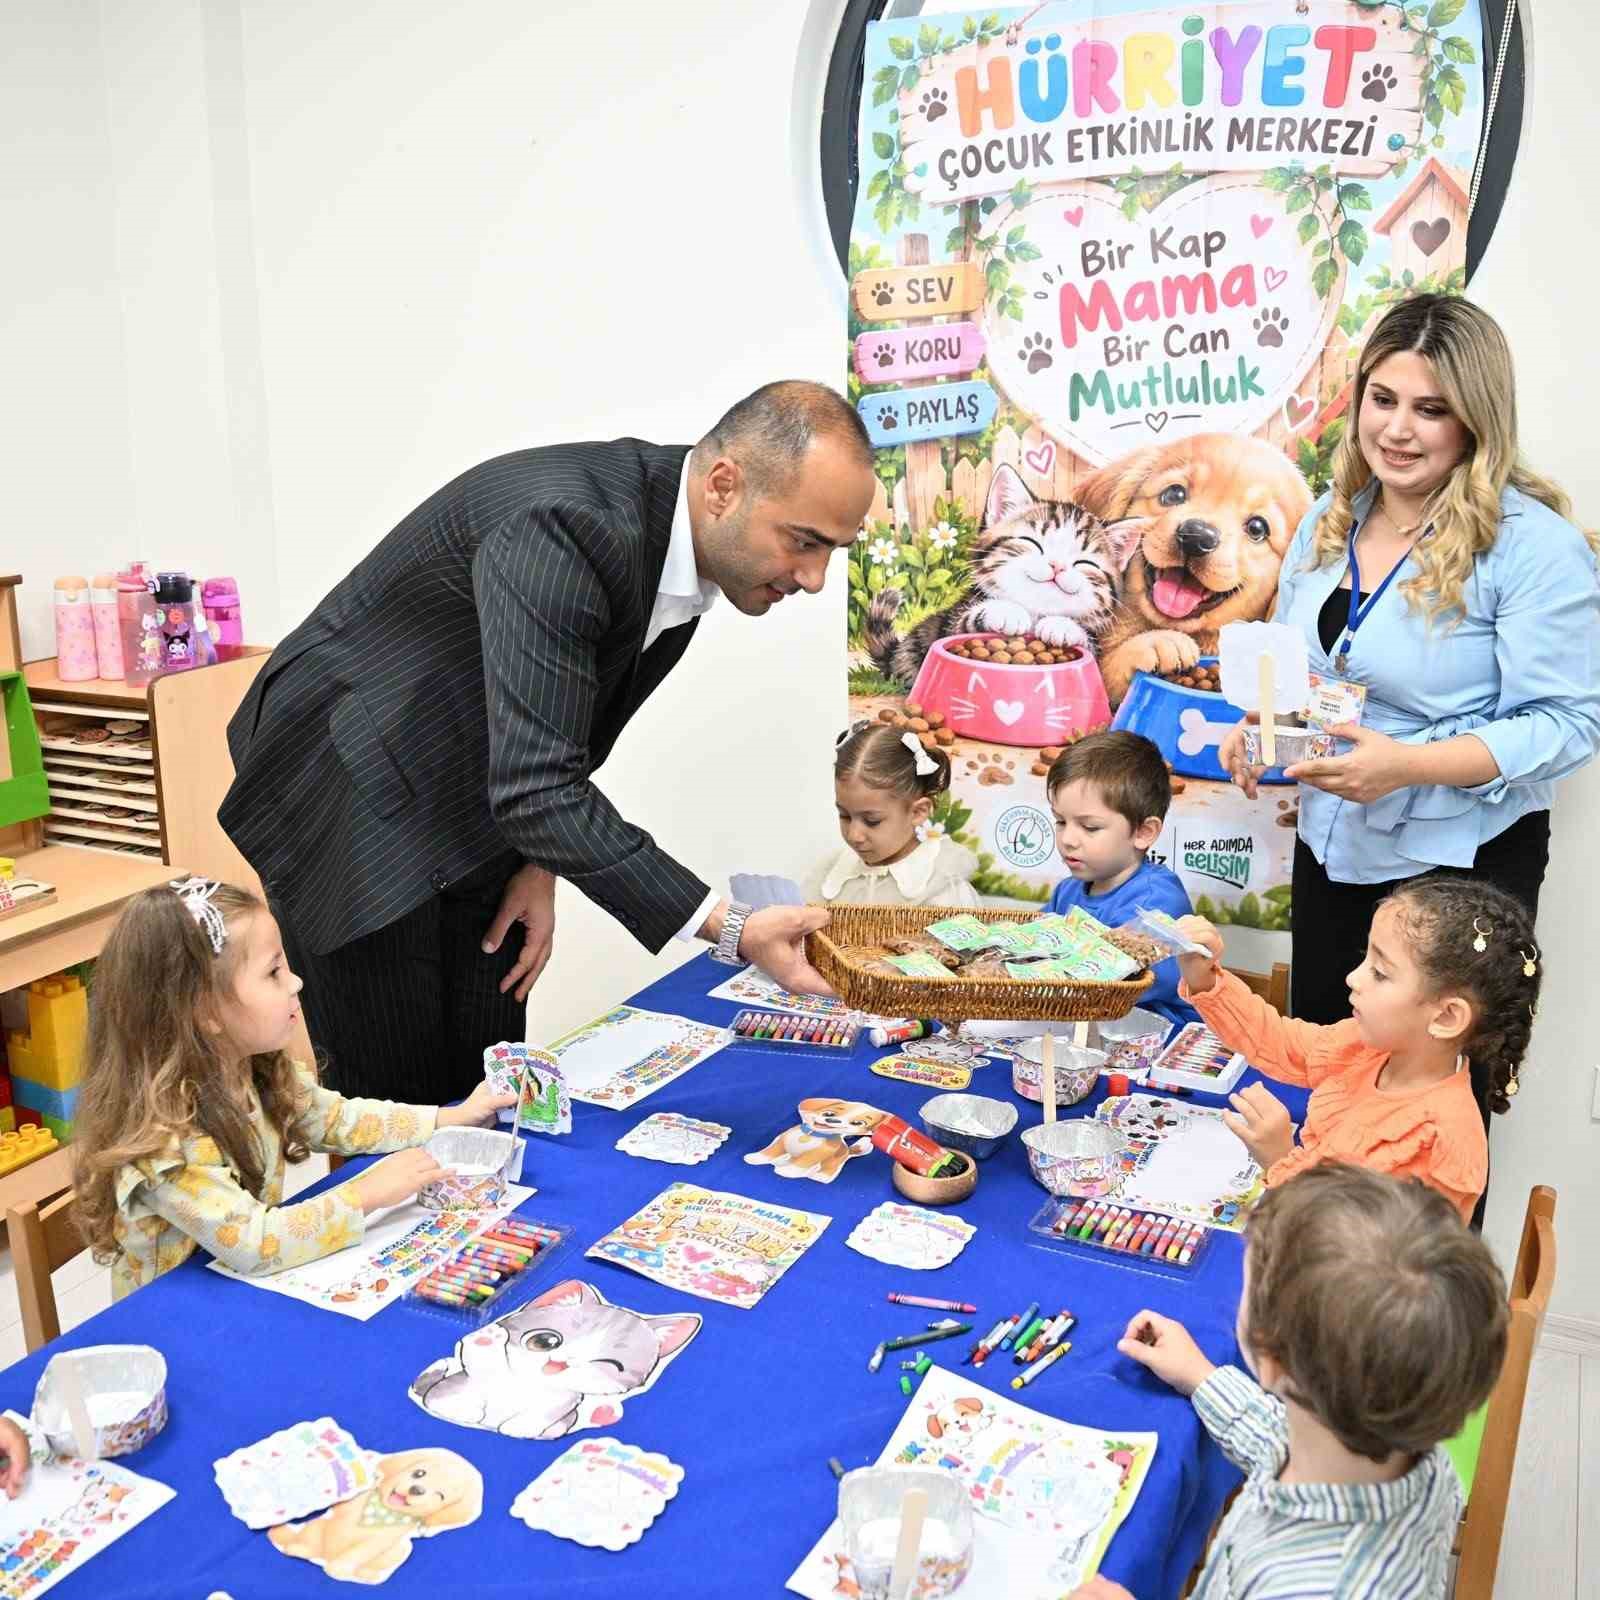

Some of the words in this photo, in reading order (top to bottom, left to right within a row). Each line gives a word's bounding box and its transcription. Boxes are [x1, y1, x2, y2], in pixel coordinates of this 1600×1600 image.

[955, 15, 1377, 138] HÜRRİYET
[938, 131, 1054, 190] ÇOCUK
[1067, 111, 1214, 164] ETKİNLİK
[1226, 115, 1378, 156] MERKEZİ
[1080, 239, 1135, 277] Bir
[1150, 226, 1227, 266] Kap
[905, 276, 955, 306] SEV
[1058, 263, 1257, 349] Mama
[904, 337, 963, 364] KORU
[1103, 334, 1150, 368] Bir
[1162, 323, 1231, 356] Can
[906, 393, 981, 427] PAYLAŞ
[1068, 355, 1265, 422] Mutluluk
[1210, 836, 1253, 853] ADIMDA
[752, 1207, 791, 1226] MAMA
